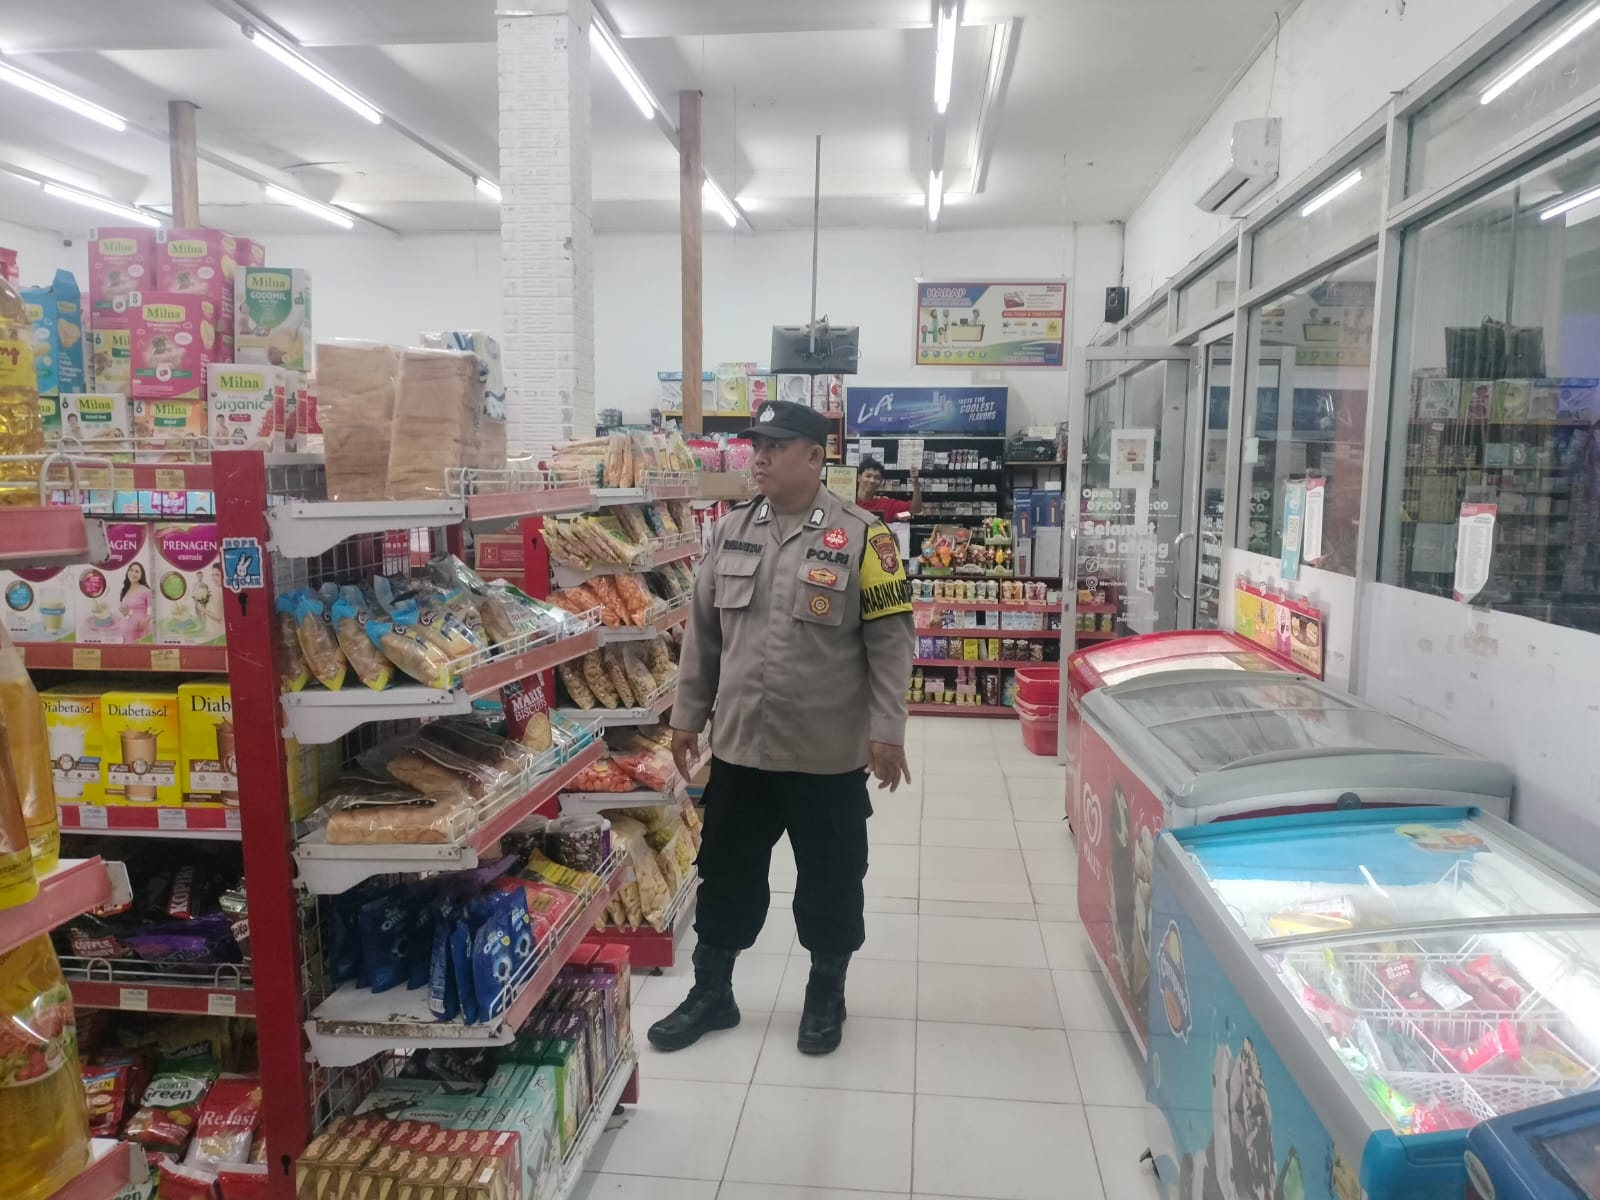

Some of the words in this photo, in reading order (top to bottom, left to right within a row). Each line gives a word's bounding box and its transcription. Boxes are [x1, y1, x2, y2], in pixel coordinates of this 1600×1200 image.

[172, 243, 203, 254] Milna
[252, 277, 286, 288] Milna
[250, 291, 287, 301] GOODMIL
[147, 307, 181, 319] Milna
[220, 375, 259, 389] Milna
[79, 399, 111, 410] Milna
[155, 403, 187, 415] Milna
[214, 399, 266, 412] organic
[960, 402, 995, 413] COOLEST
[1087, 501, 1121, 511] 07:00
[163, 540, 217, 551] PRENAGEN
[806, 548, 850, 565] POLRI
[512, 686, 545, 712] MARIE
[108, 703, 168, 718] Diabetasol
[514, 699, 548, 722] BISCUITS
[143, 1087, 192, 1102] Green
